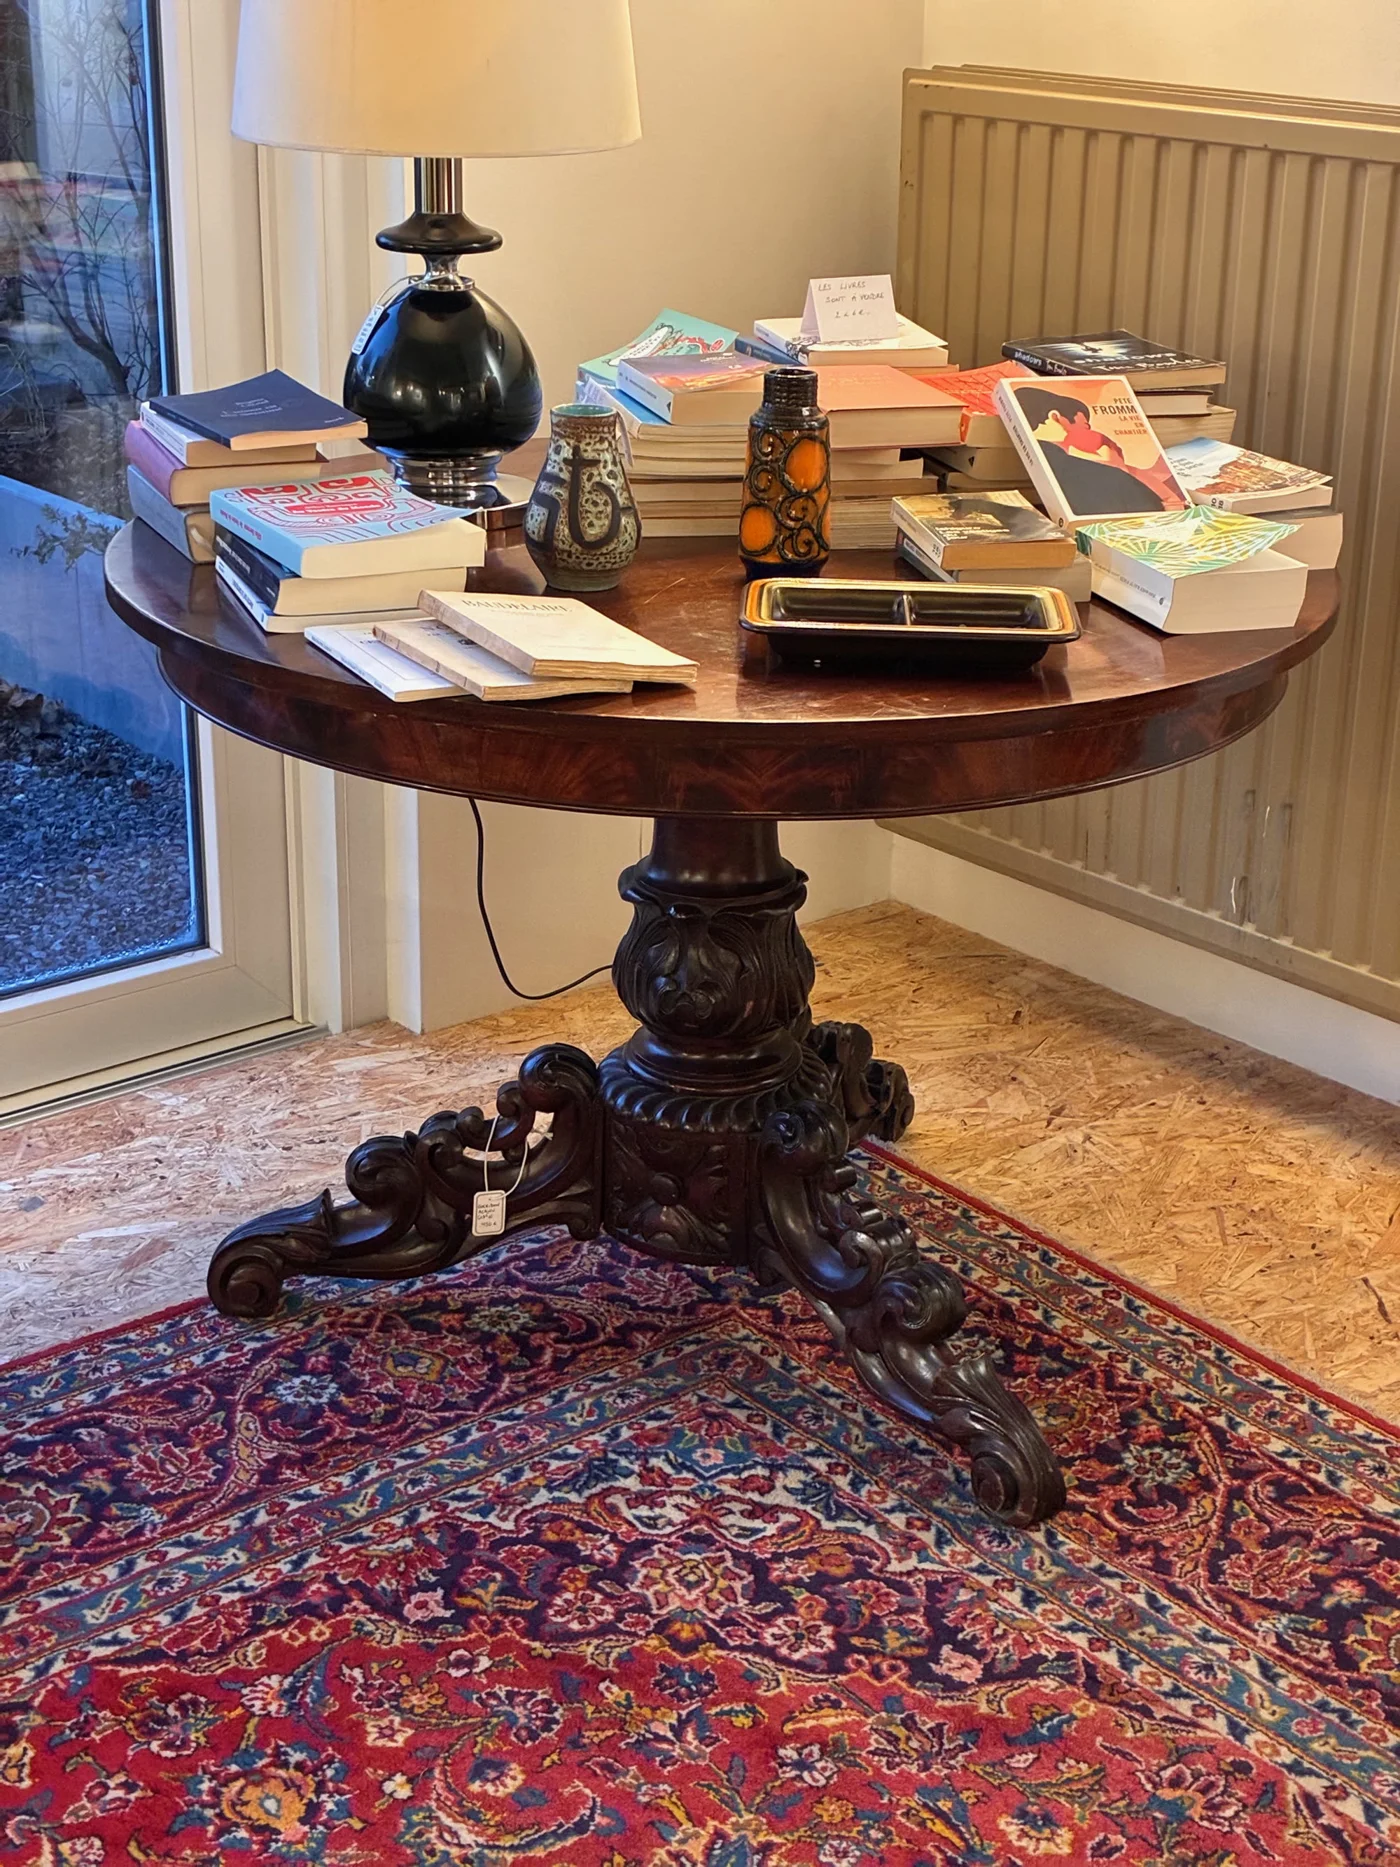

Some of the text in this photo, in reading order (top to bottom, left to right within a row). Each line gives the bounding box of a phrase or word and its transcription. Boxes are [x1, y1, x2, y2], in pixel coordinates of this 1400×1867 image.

[818, 281, 866, 291] LES LIVRES
[1014, 351, 1042, 366] shadows
[1074, 352, 1176, 364] shadows
[1092, 404, 1138, 415] FROMM
[461, 599, 573, 612] BAUDELAIRE
